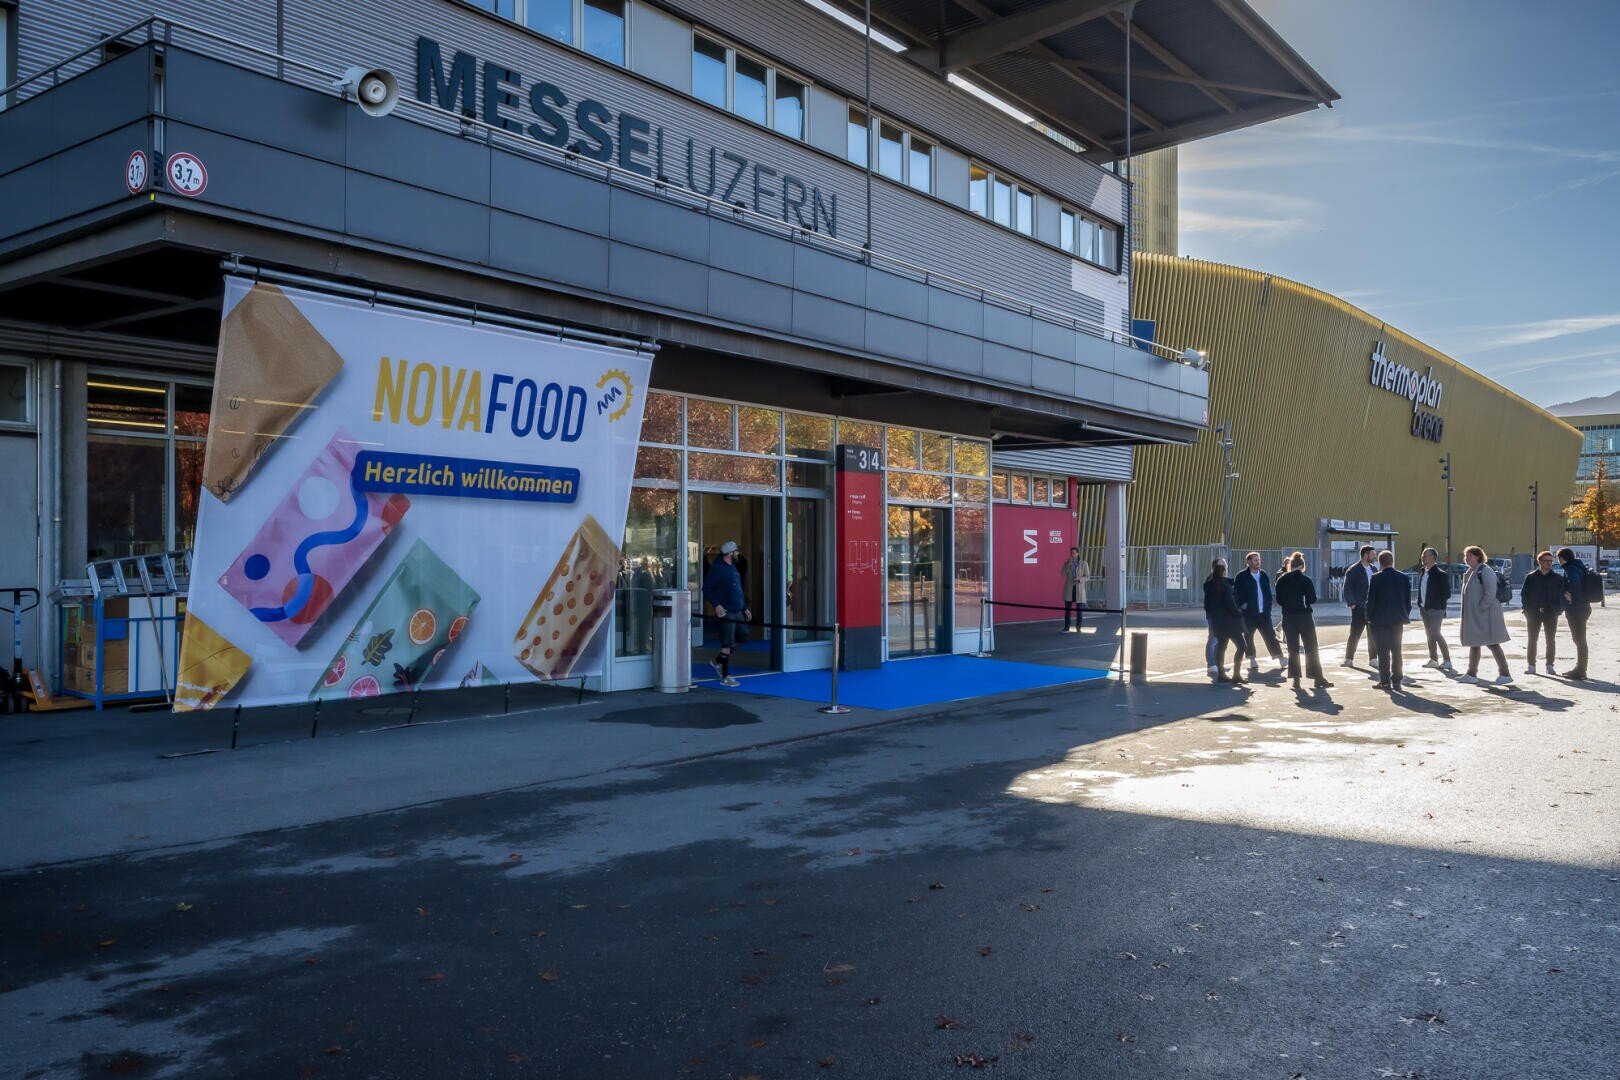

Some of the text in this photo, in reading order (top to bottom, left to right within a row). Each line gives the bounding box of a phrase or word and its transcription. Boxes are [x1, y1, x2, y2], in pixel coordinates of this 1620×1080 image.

[1369, 340, 1443, 413] thermoplan
[364, 461, 574, 495] Herzlich willkommen
